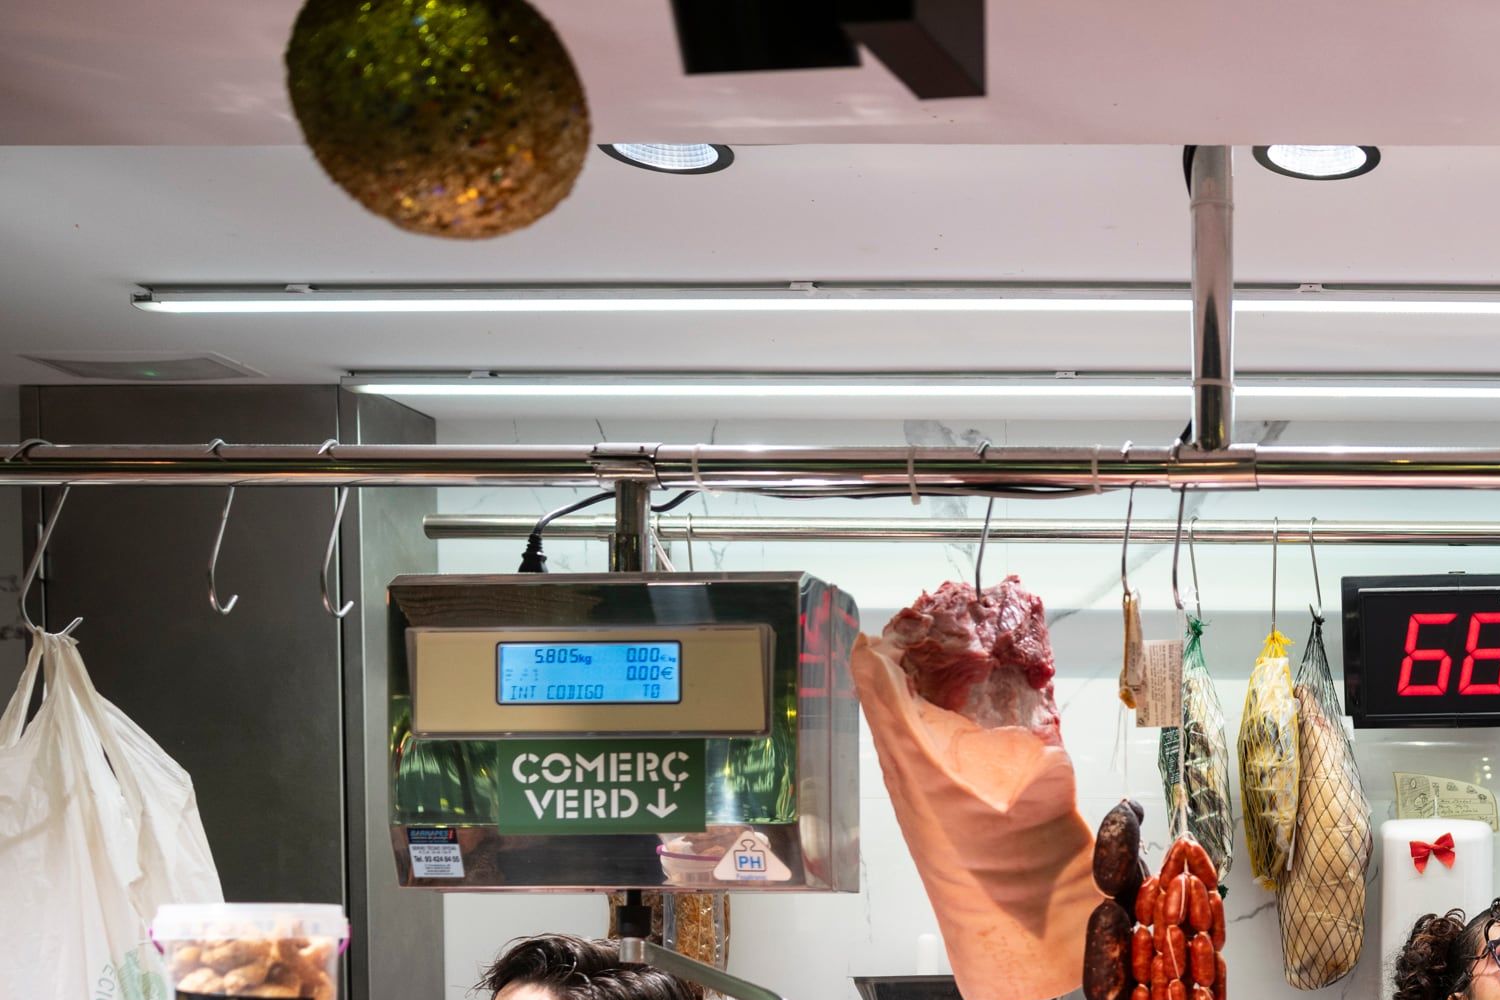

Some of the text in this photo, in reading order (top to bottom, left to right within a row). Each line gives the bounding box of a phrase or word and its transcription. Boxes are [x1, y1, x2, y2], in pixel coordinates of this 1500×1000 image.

[546, 684, 604, 700] CODIGO
[511, 751, 690, 791] COMERÇ
[524, 789, 639, 820] VERD
[738, 855, 762, 868] PH
